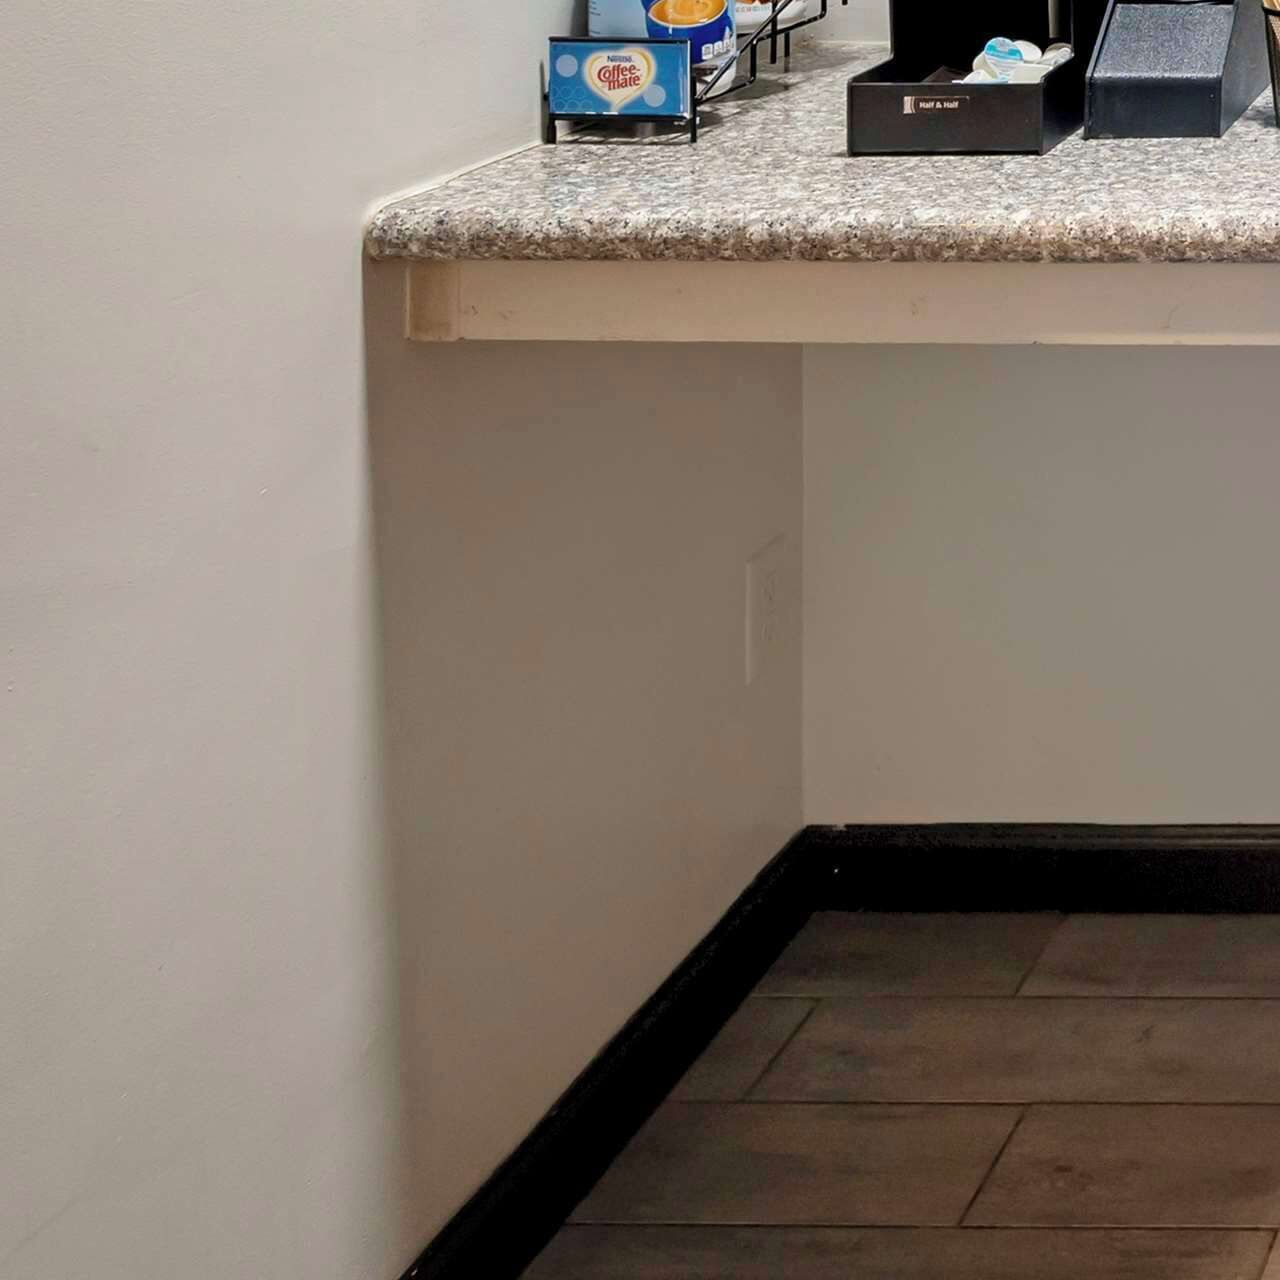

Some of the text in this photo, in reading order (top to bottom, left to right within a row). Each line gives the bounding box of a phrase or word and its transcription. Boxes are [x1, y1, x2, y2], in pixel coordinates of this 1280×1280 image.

[607, 74, 640, 91] mate
[919, 101, 934, 109] Half
[944, 101, 959, 109] Half
